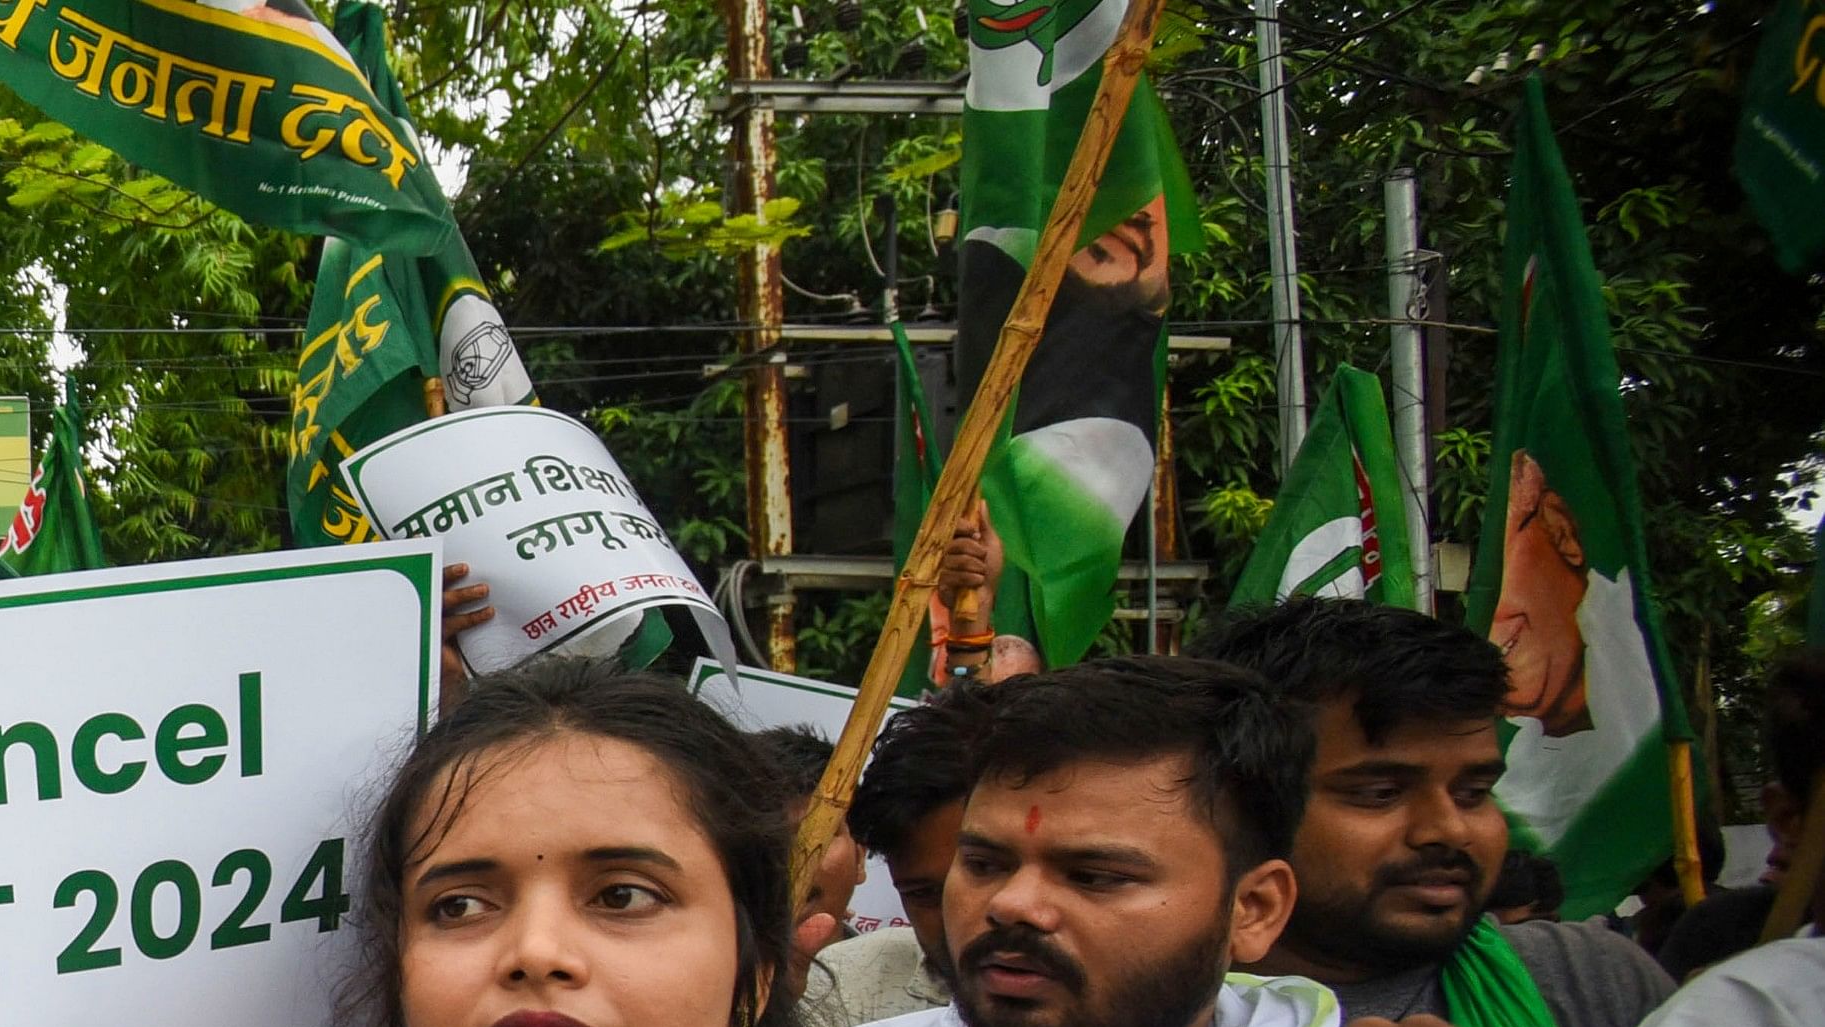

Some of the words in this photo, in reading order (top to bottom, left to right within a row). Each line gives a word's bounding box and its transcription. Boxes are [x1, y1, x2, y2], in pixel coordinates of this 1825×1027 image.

[49, 8, 275, 144] जनता
[280, 84, 418, 191] दल
[337, 190, 388, 212] Printers
[506, 510, 628, 561] लागू
[522, 610, 558, 640] छात्र
[556, 581, 618, 619] राष्ट्रीय
[620, 573, 679, 590] जनता
[52, 837, 351, 978] 2024
